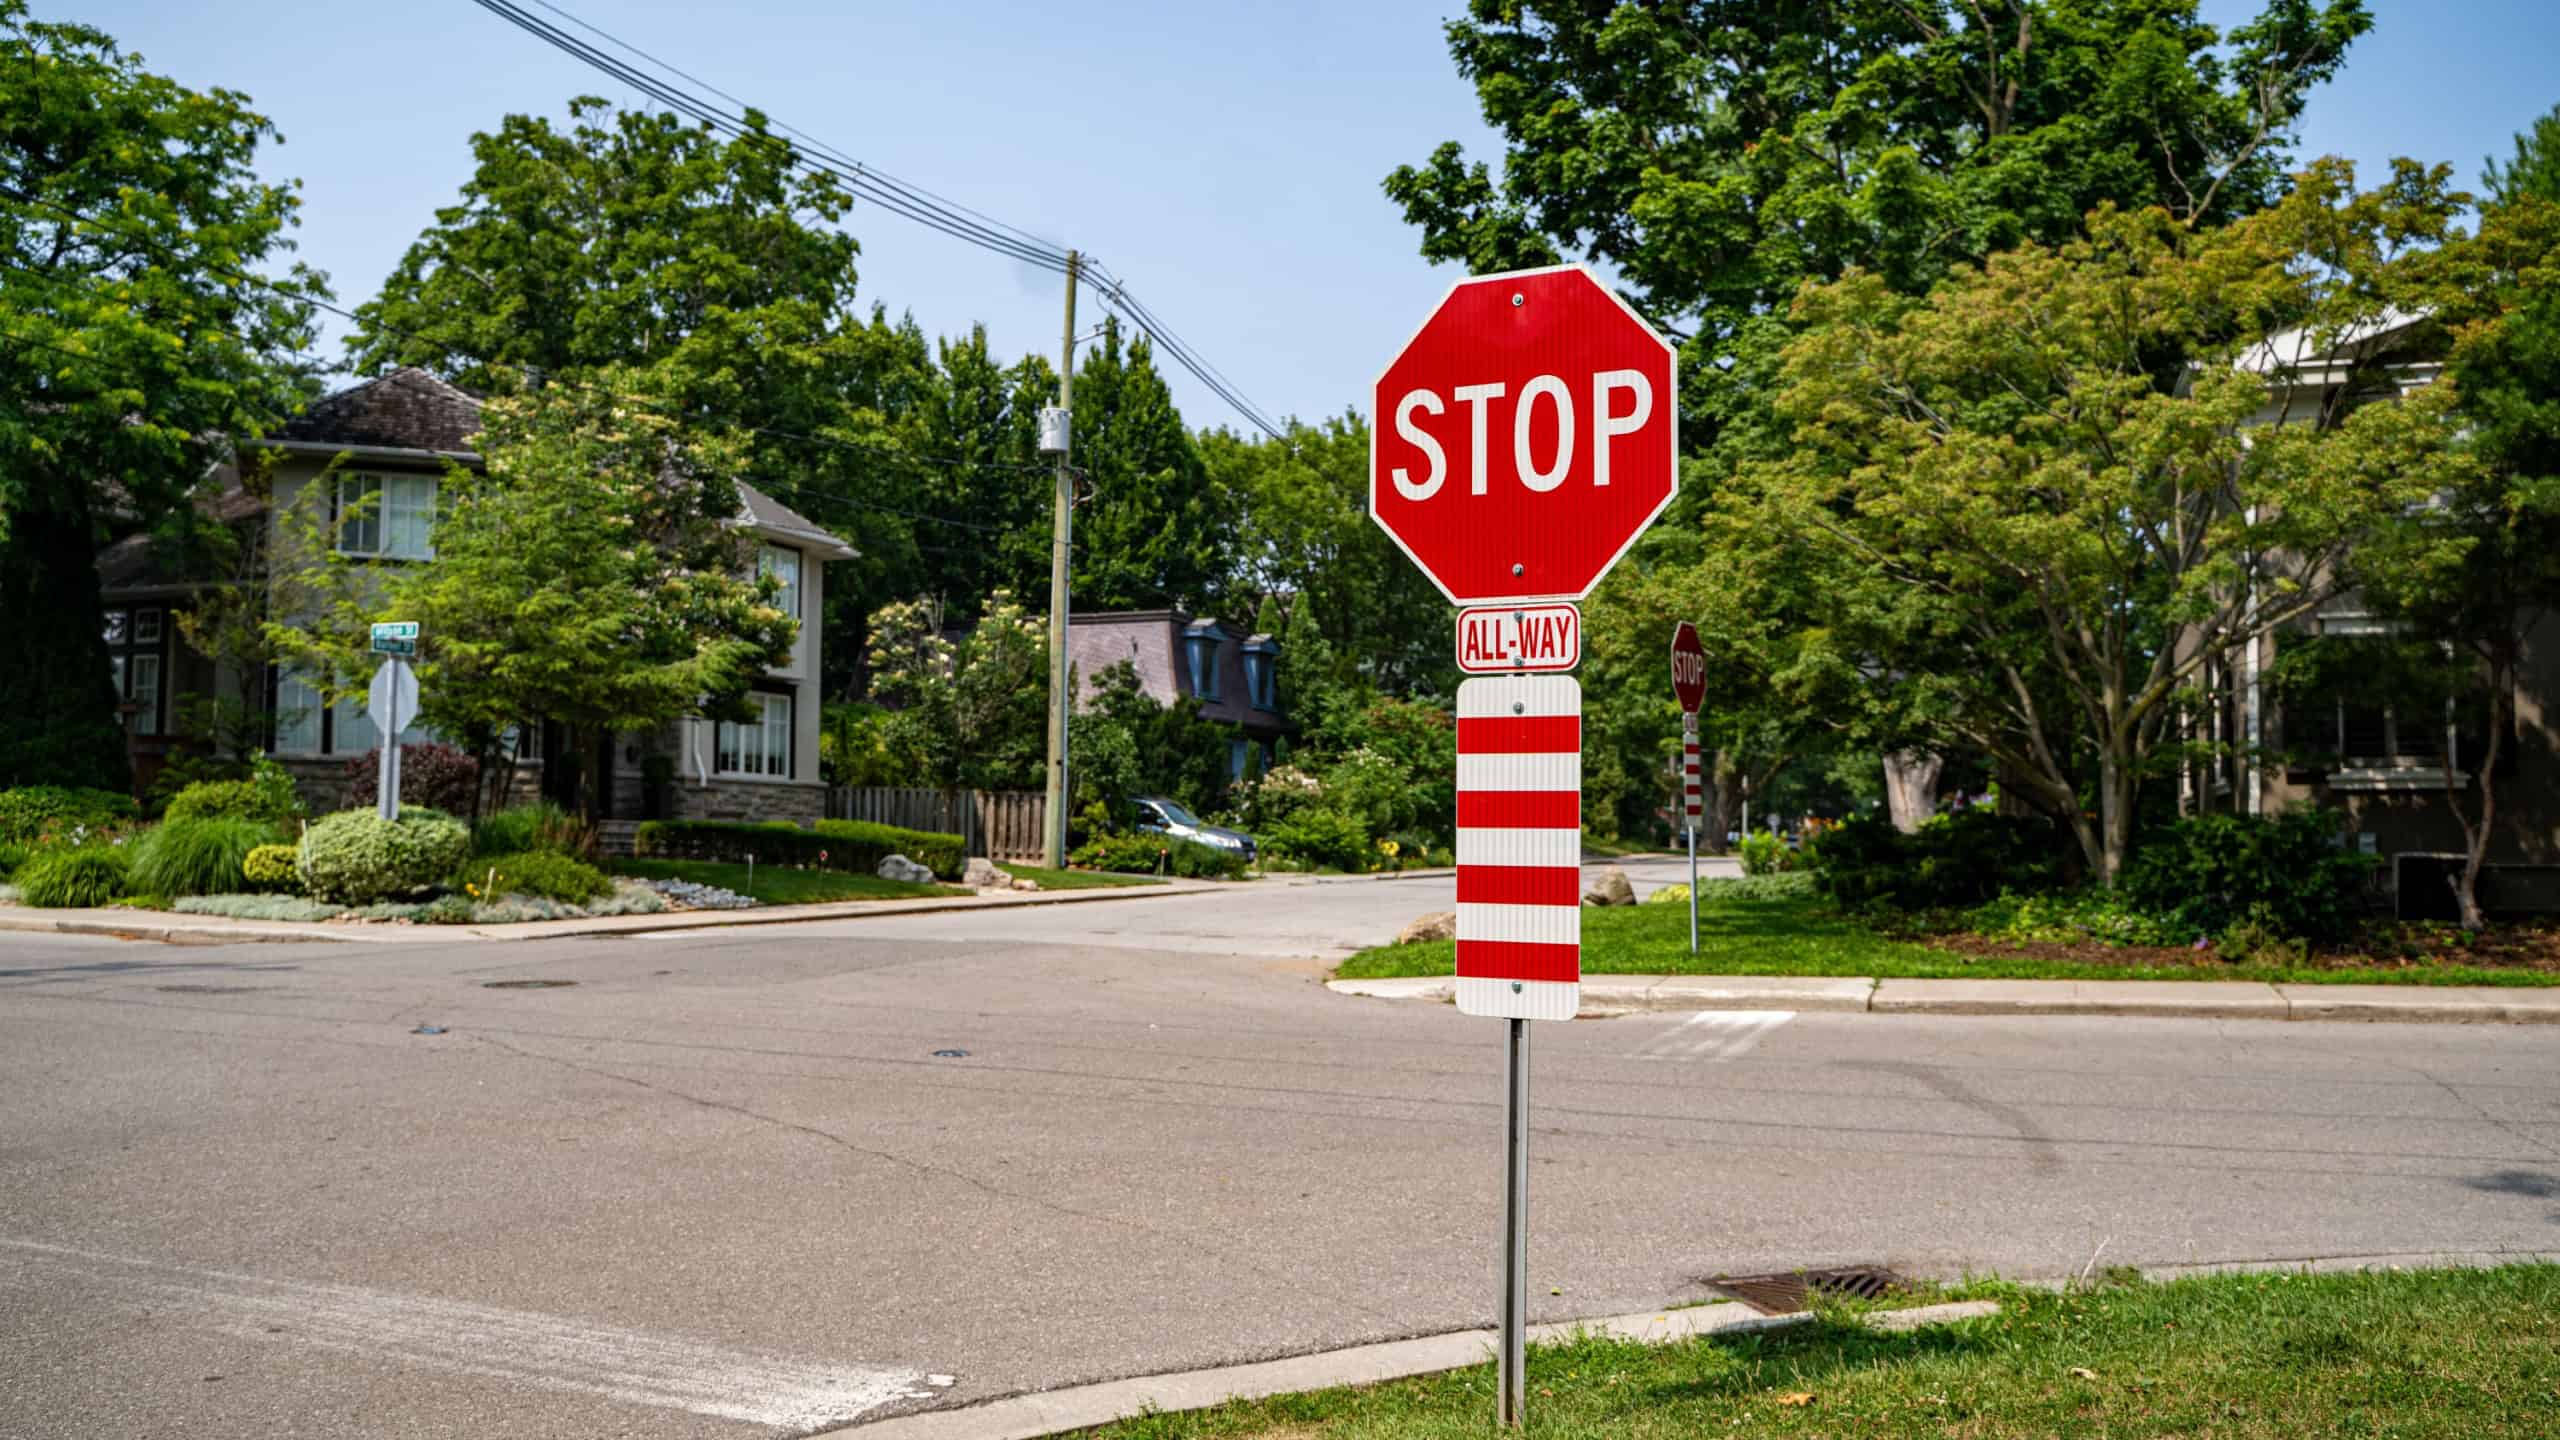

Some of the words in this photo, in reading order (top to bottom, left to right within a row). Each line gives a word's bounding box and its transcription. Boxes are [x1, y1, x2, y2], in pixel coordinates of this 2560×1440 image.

[1391, 369, 1653, 501] STOP
[1465, 615, 1570, 661] ALL-WAY
[1674, 650, 1704, 686] STOP
